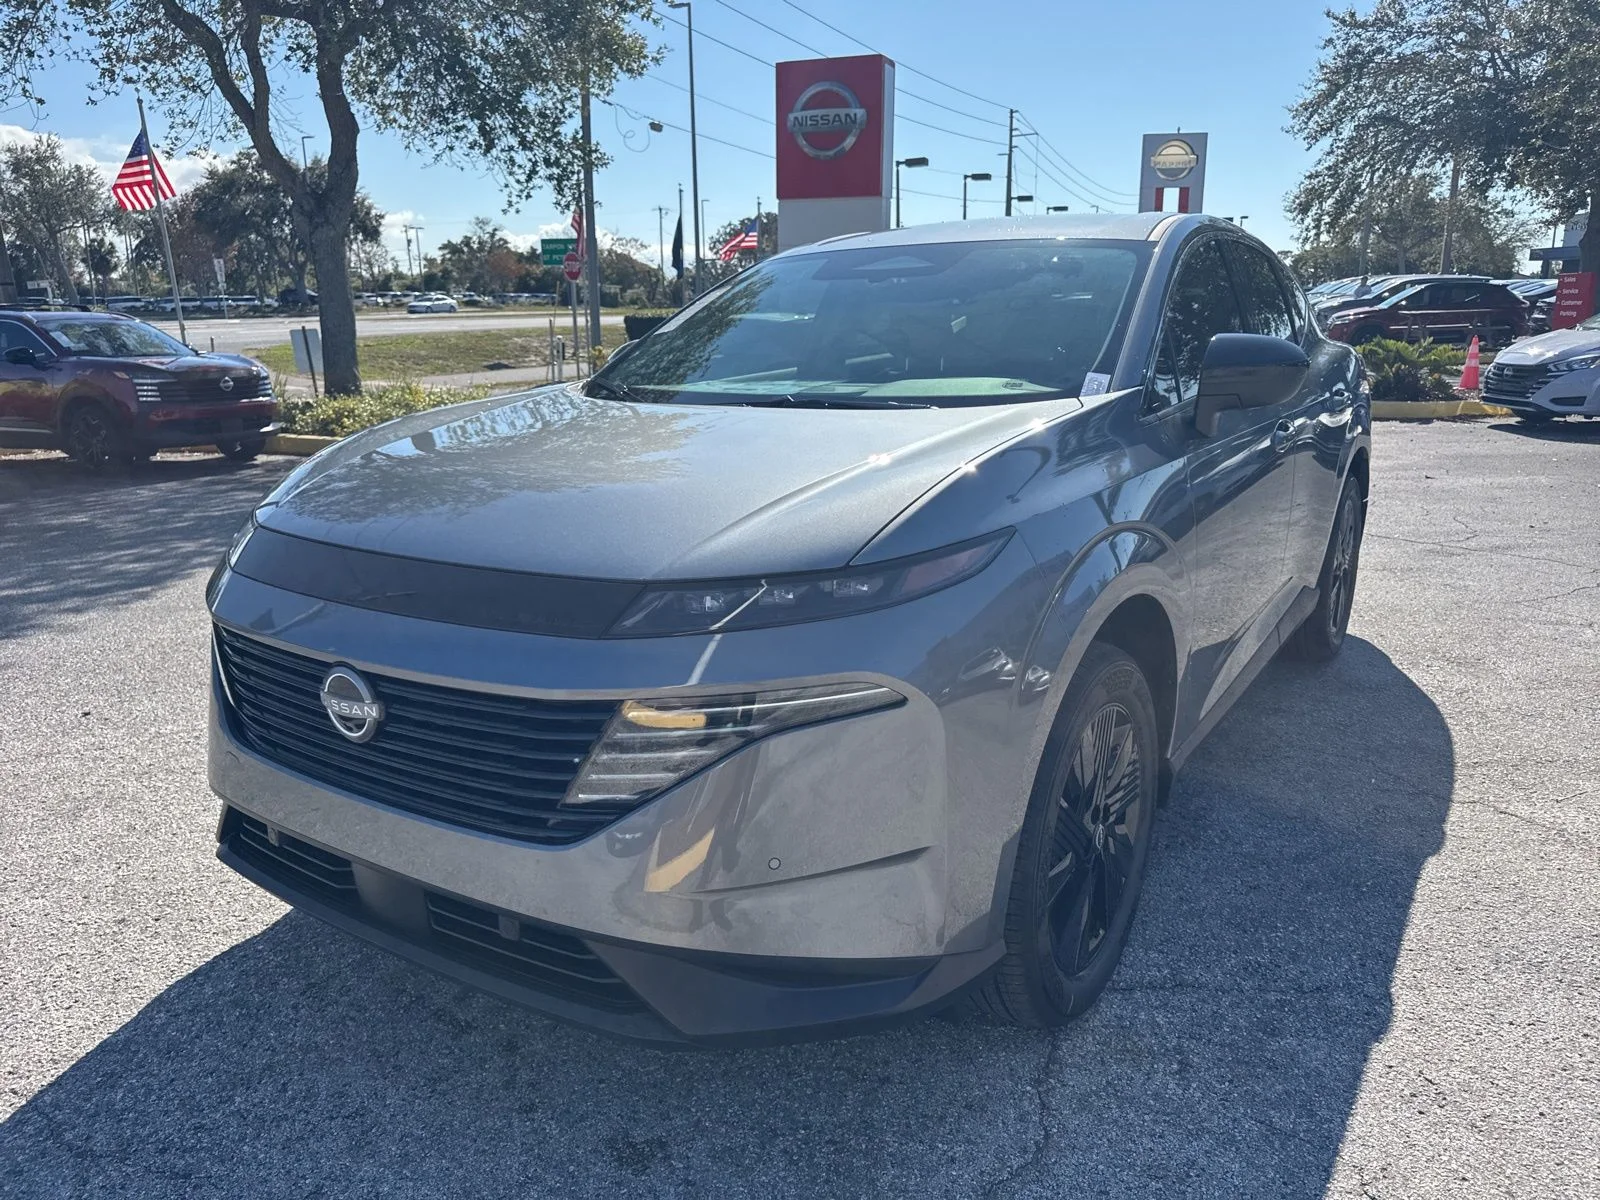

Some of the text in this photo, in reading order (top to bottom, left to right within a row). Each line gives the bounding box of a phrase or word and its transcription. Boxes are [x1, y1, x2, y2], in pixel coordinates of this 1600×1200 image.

[792, 112, 858, 128] NISSAN
[564, 261, 580, 270] STOP
[328, 697, 376, 717] SSAN
